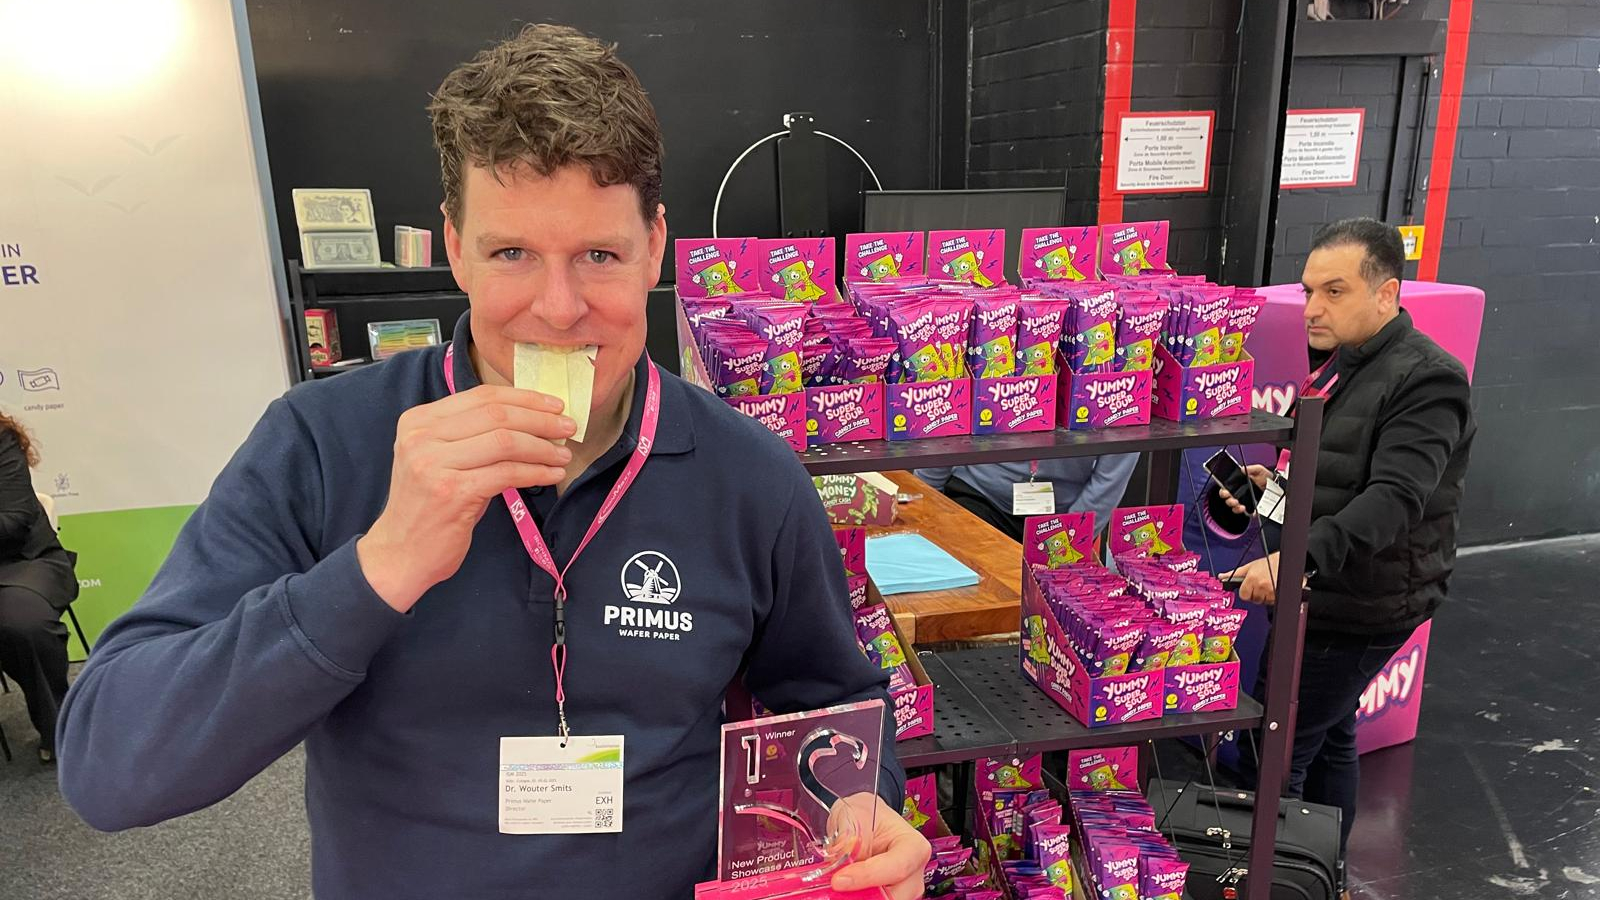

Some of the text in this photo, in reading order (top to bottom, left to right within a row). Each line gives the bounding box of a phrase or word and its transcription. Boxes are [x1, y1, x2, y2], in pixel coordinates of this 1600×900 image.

[1, 244, 20, 258] IN
[858, 244, 888, 258] CHALLENGE
[940, 242, 970, 254] CHALLENGE
[1034, 237, 1062, 250] CHALLENGE
[688, 250, 720, 264] CHALLENGE
[690, 249, 704, 258] TAKE
[768, 251, 799, 264] CHALLENGE
[770, 250, 784, 258] TAKE
[1079, 290, 1114, 312] YUMMY
[978, 303, 1016, 325] YUMMY
[989, 314, 1011, 330] SUPER
[1022, 311, 1060, 331] YUMMY
[1126, 310, 1164, 329] YUMMY
[764, 318, 802, 340] YUMMY
[898, 312, 933, 339] YUMMY
[910, 324, 931, 342] SUPER
[1032, 322, 1054, 336] SUPER
[774, 330, 798, 345] SUPER
[724, 352, 764, 370] YUMMY
[1086, 376, 1136, 400] YUMMY
[1195, 367, 1240, 391] YUMMY
[812, 386, 864, 412] YUMMY
[901, 382, 952, 408] YUMMY
[988, 378, 1038, 402] YUMMY
[1097, 390, 1126, 408] SUPER
[1206, 382, 1232, 399] SUPER
[1216, 386, 1238, 404] SOUR
[914, 397, 944, 416] SUPER
[1000, 392, 1030, 410] SUPER
[1013, 396, 1038, 416] SOUR
[1109, 394, 1134, 413] SOUR
[826, 402, 856, 420] SUPER
[838, 406, 864, 426] SOUR
[927, 401, 952, 422] SOUR
[817, 485, 856, 500] MONEY
[1036, 523, 1062, 535] CHALLENGE
[604, 605, 692, 632] PRIMUS
[1167, 609, 1205, 624] YUMMY
[1206, 614, 1241, 627] YUMMY
[619, 629, 680, 640] WAFER PAPER
[1104, 630, 1140, 648] YUMMY
[1150, 629, 1184, 646] YUMMY
[1047, 634, 1076, 676] YUMMY
[1174, 668, 1223, 688] YUMMY
[1103, 676, 1149, 700] YUMMY
[1186, 680, 1214, 695] SUPER
[1198, 684, 1221, 700] SOUR
[1114, 690, 1141, 706] SUPER
[1125, 692, 1148, 710] SOUR
[766, 730, 796, 741] Winner
[596, 796, 613, 804] EXH
[1040, 833, 1068, 850] YUMMY
[732, 850, 795, 870] New Product
[732, 856, 814, 880] Showcase Award
[1104, 858, 1138, 873] YUMMY
[732, 876, 768, 892] 2025
[1152, 871, 1186, 884] YUMMY
